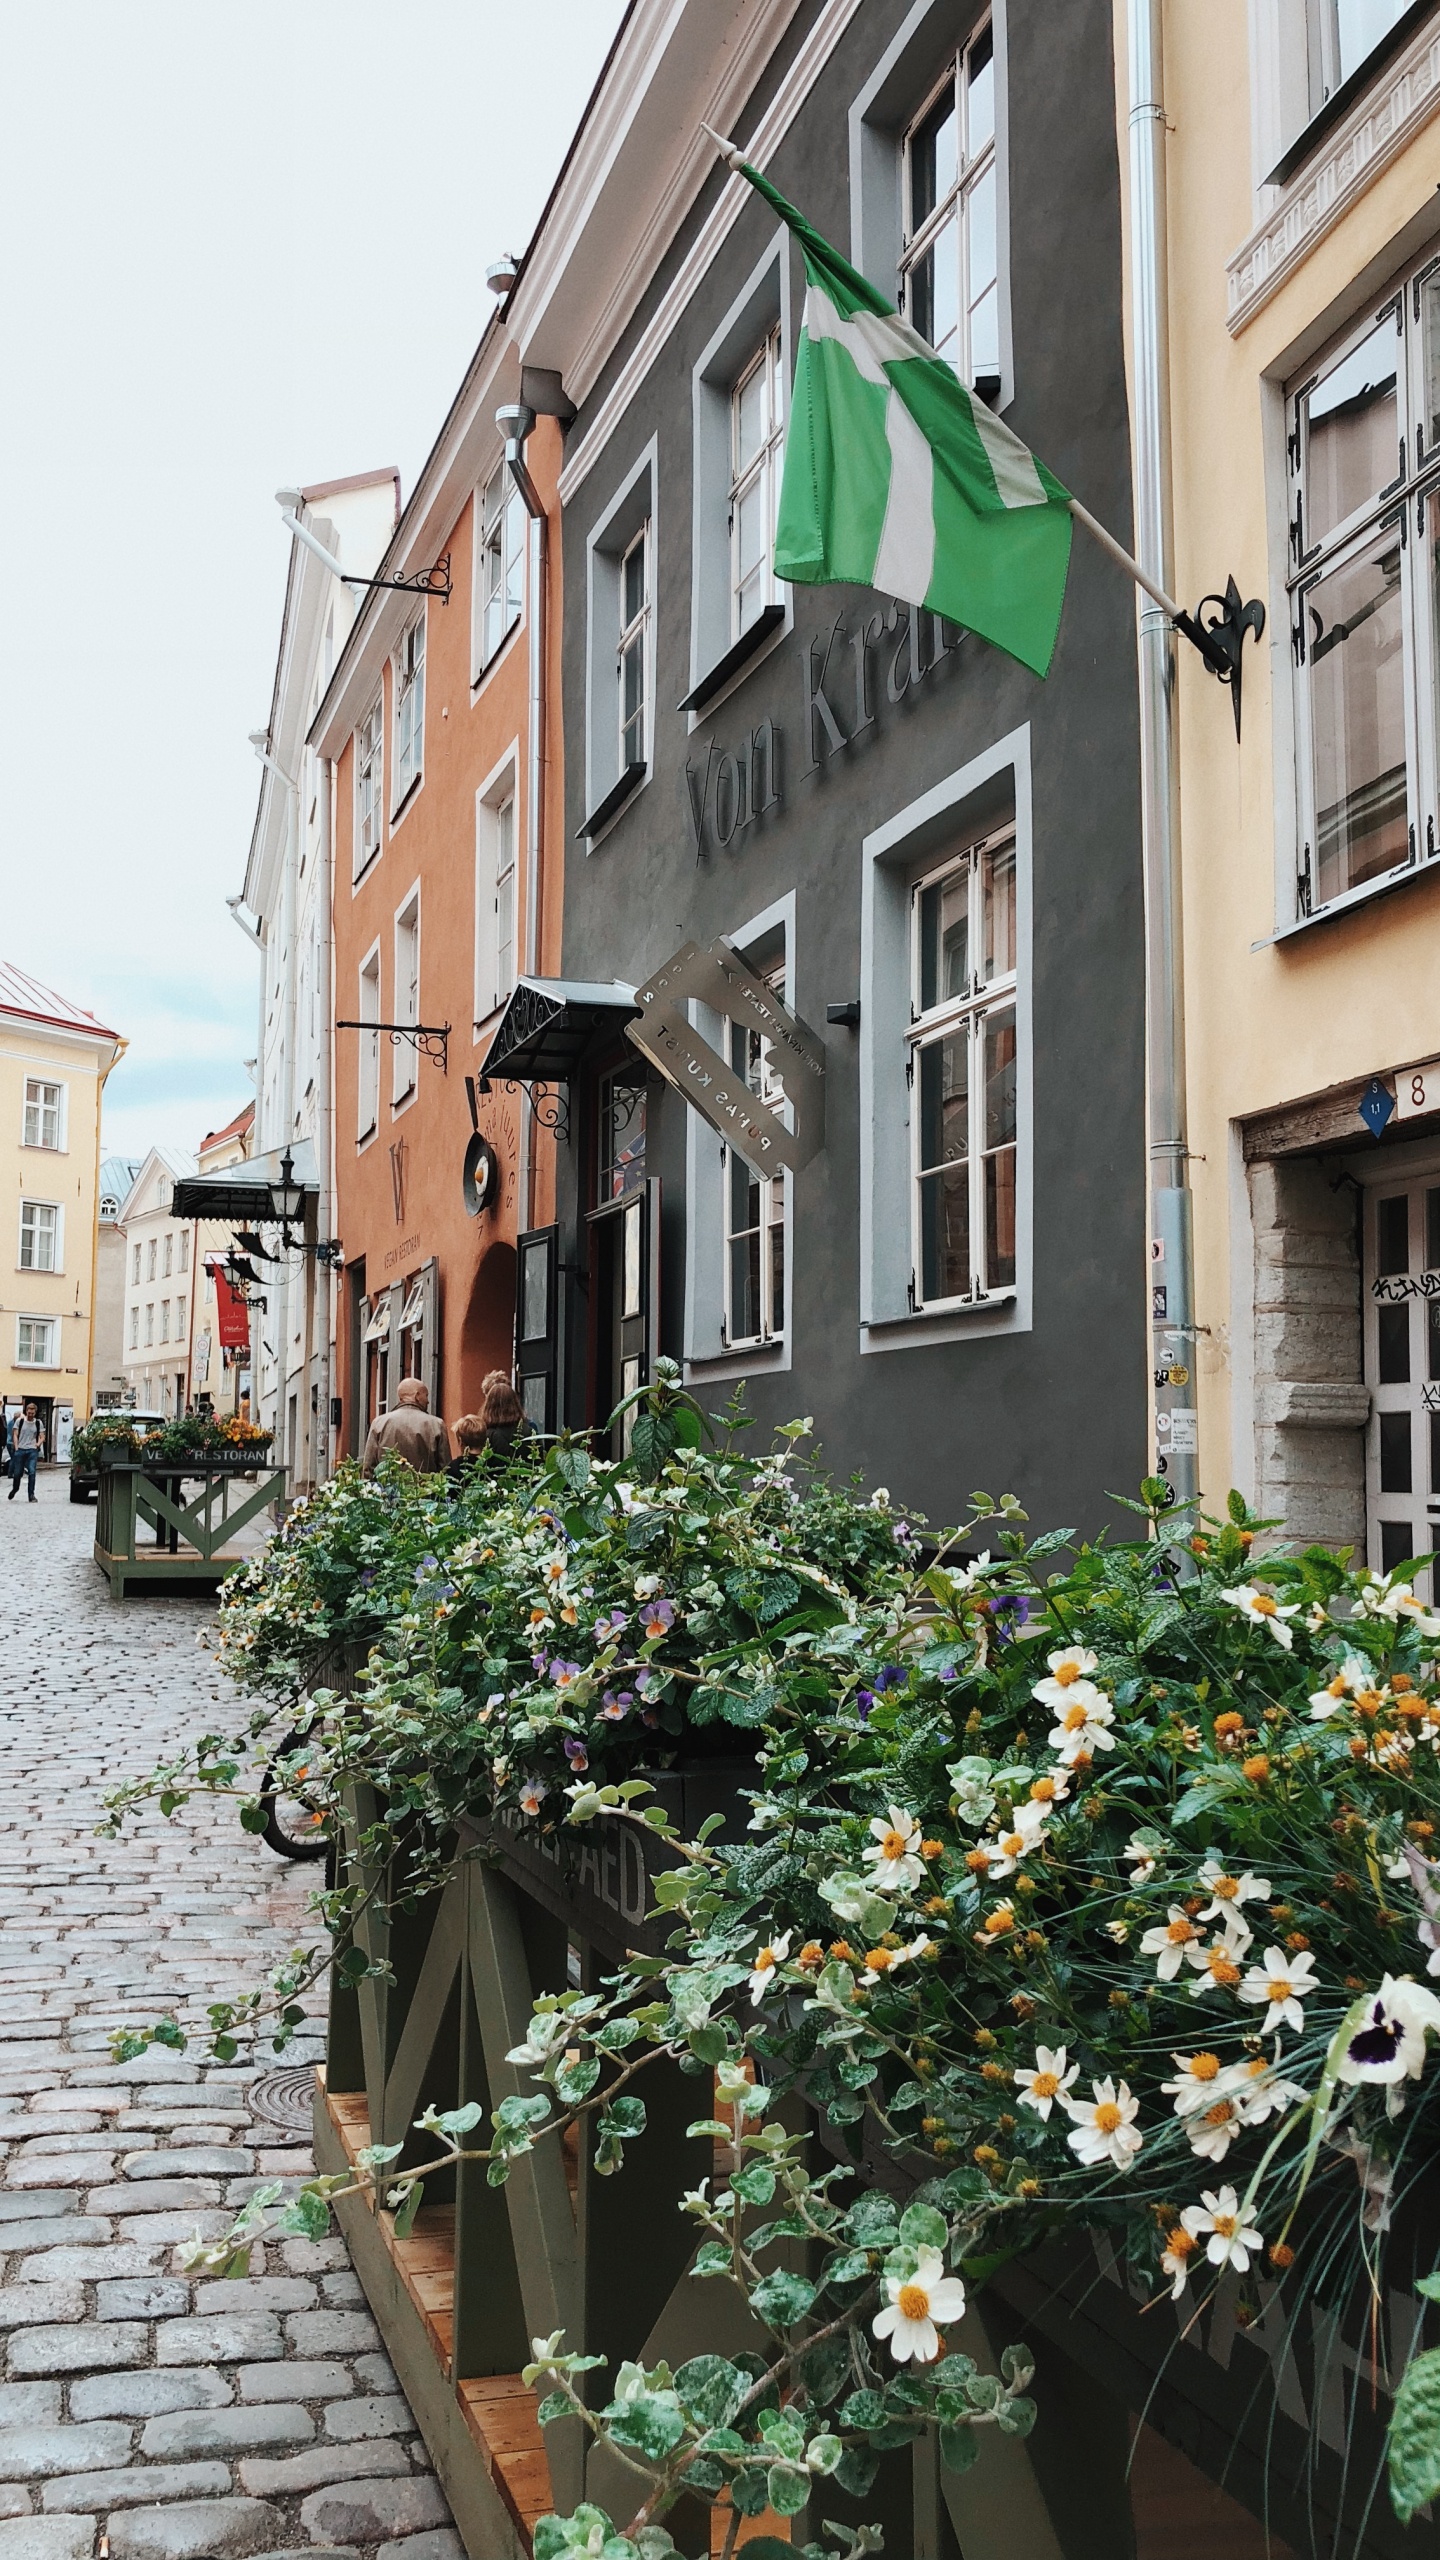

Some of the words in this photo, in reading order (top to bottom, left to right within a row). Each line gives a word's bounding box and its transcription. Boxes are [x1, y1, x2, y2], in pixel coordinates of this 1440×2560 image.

[685, 716, 782, 868] Von
[798, 597, 973, 783] Kra
[1372, 1082, 1378, 1094] S
[1411, 1074, 1425, 1106] 8
[194, 1449, 265, 1461] RESTORAN
